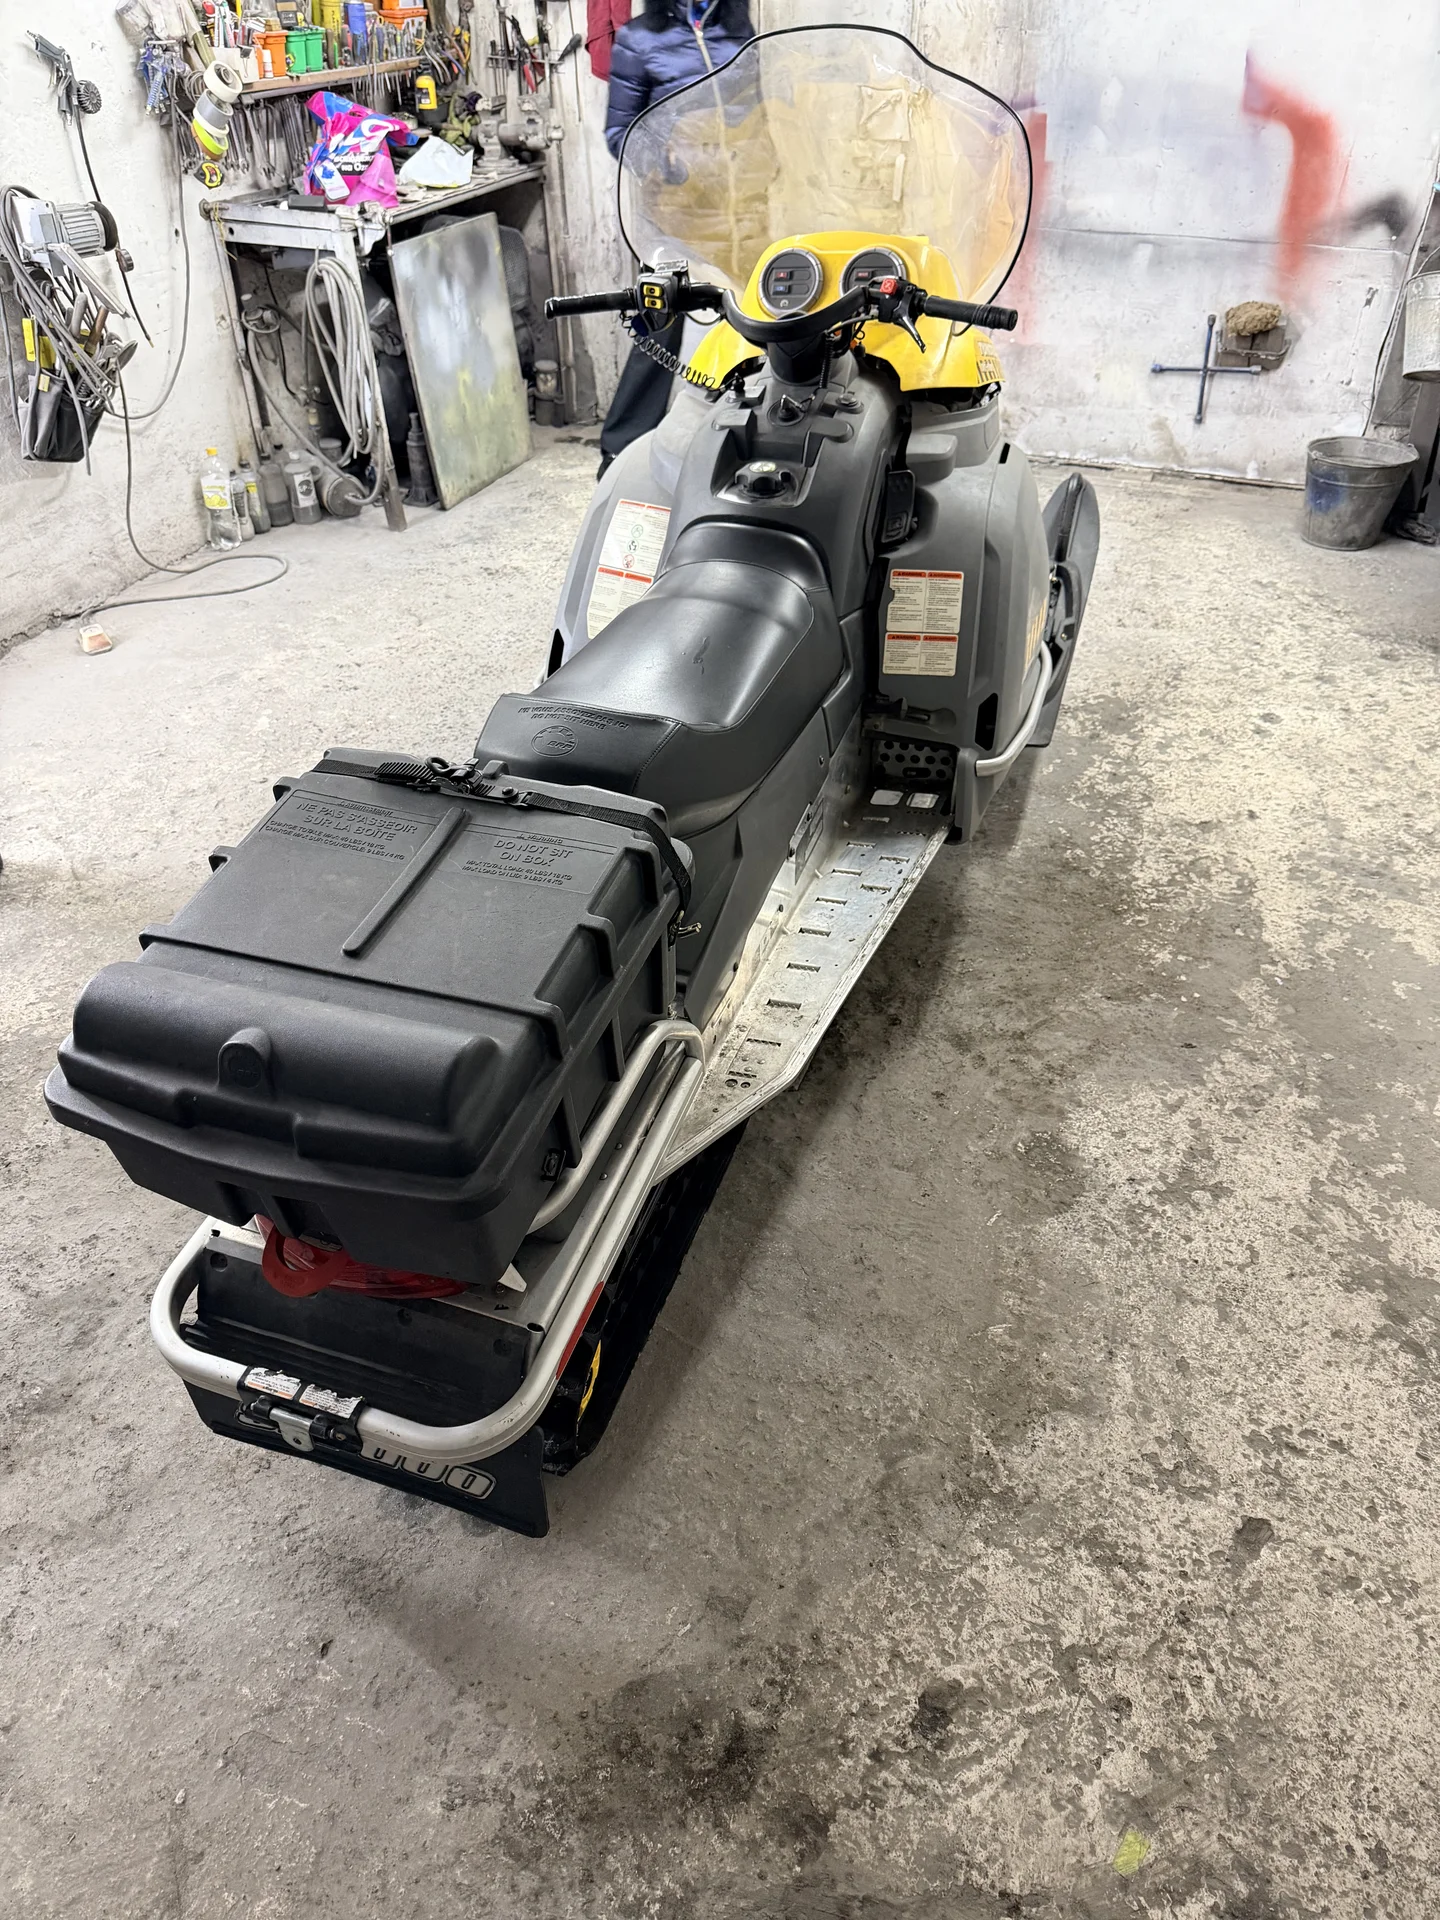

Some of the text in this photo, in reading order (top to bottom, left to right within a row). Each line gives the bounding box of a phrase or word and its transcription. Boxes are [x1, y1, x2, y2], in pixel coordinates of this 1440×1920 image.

[531, 706, 554, 714] VOUS
[554, 706, 596, 720] ASSOYEZ
[594, 714, 614, 726] PAS
[563, 714, 581, 724] SIT
[579, 718, 607, 731] HERE
[296, 803, 418, 835] NE PAS S'ASSEOIR
[303, 815, 333, 829] SUR
[333, 822, 351, 833] LA
[493, 840, 573, 859] DO NOT SIT
[499, 852, 555, 867] ON BOX
